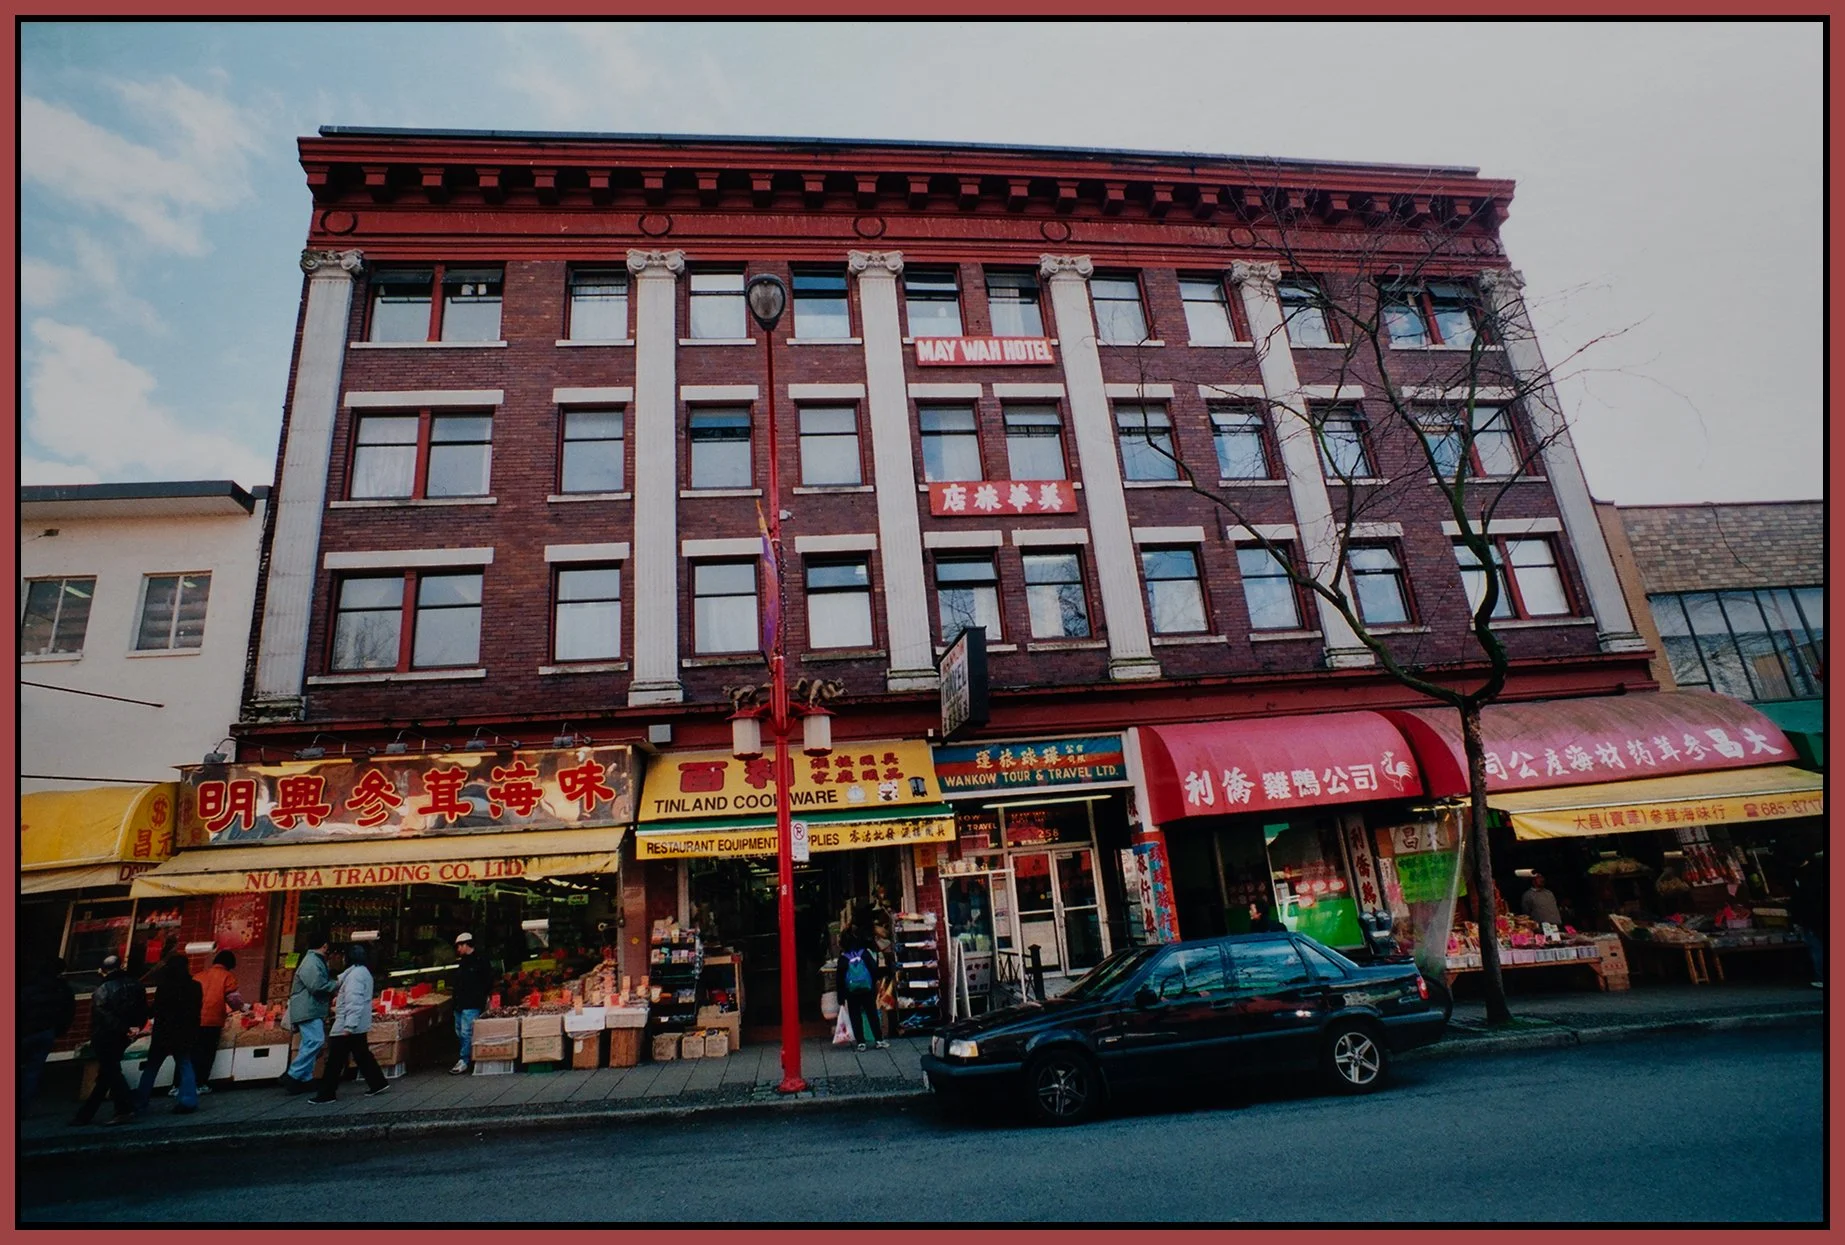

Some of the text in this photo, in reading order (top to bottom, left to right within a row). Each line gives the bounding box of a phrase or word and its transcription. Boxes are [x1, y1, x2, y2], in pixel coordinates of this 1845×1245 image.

[917, 339, 1053, 362] MAY WAH HOTEL
[944, 766, 1119, 787] WANKOW TOUR & TRAVEL LTD.
[197, 759, 616, 833] 明興參茸海味
[654, 796, 728, 815] TINLAND
[647, 839, 715, 855] RESTAURANT
[717, 836, 778, 852] EQUIPMENT
[244, 869, 324, 891] NUTRA
[332, 864, 431, 887] TRADING
